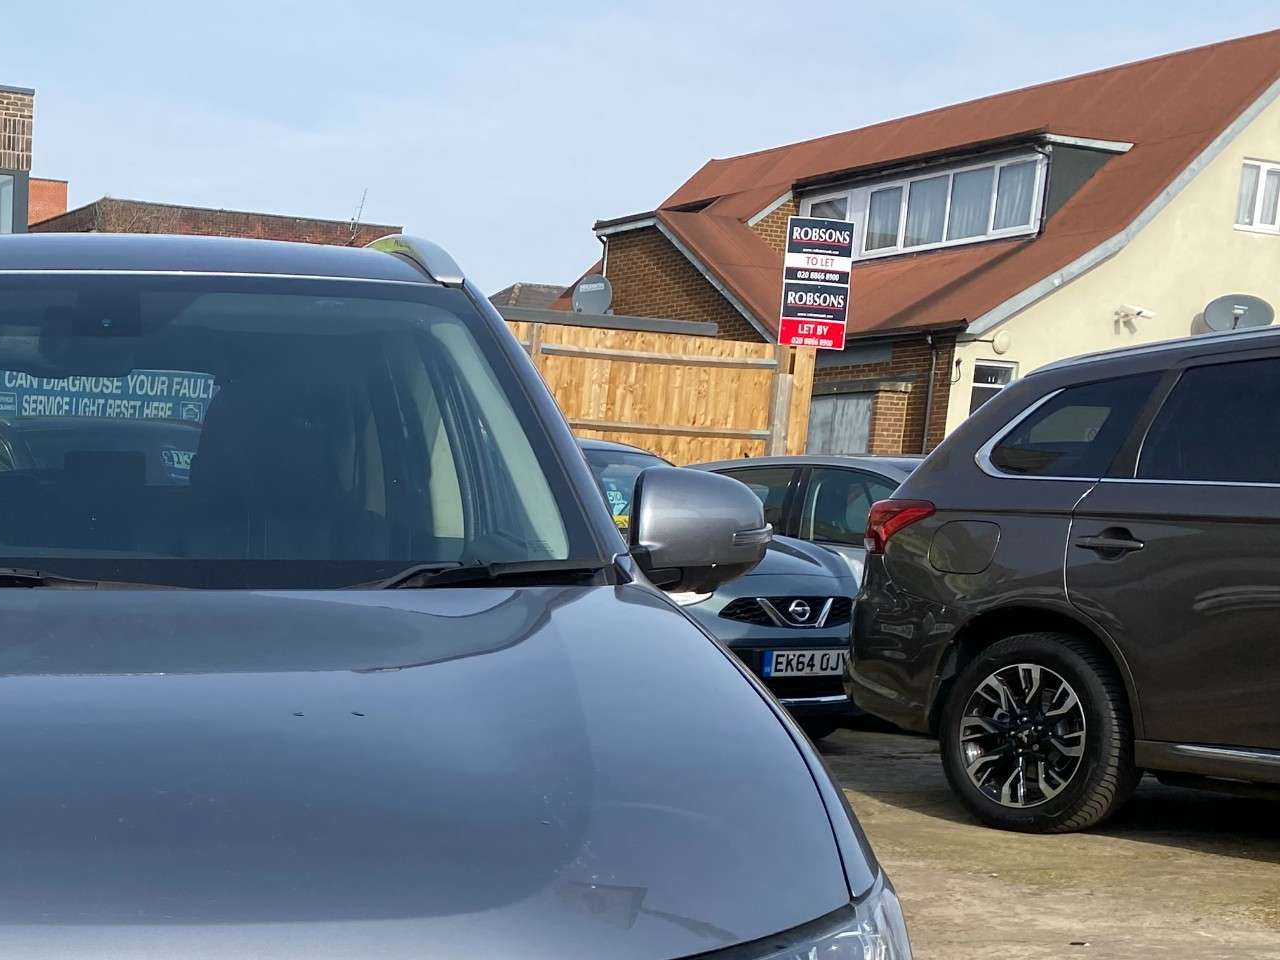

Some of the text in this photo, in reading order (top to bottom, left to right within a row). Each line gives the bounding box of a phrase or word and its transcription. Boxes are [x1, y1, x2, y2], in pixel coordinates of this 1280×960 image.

[792, 226, 851, 244] ROBSONS
[806, 256, 835, 268] TO LET
[797, 270, 810, 279] 020
[787, 291, 845, 308] ROBSONS
[798, 324, 829, 336] LET BY
[5, 371, 39, 389] CAN
[43, 376, 122, 394] DIAGNOSE
[127, 375, 169, 397] YOUR
[172, 377, 215, 399] FAULT
[22, 395, 70, 416] SERVICE
[106, 399, 142, 419] RESET
[143, 401, 173, 420] HERE
[774, 653, 815, 673] EK64
